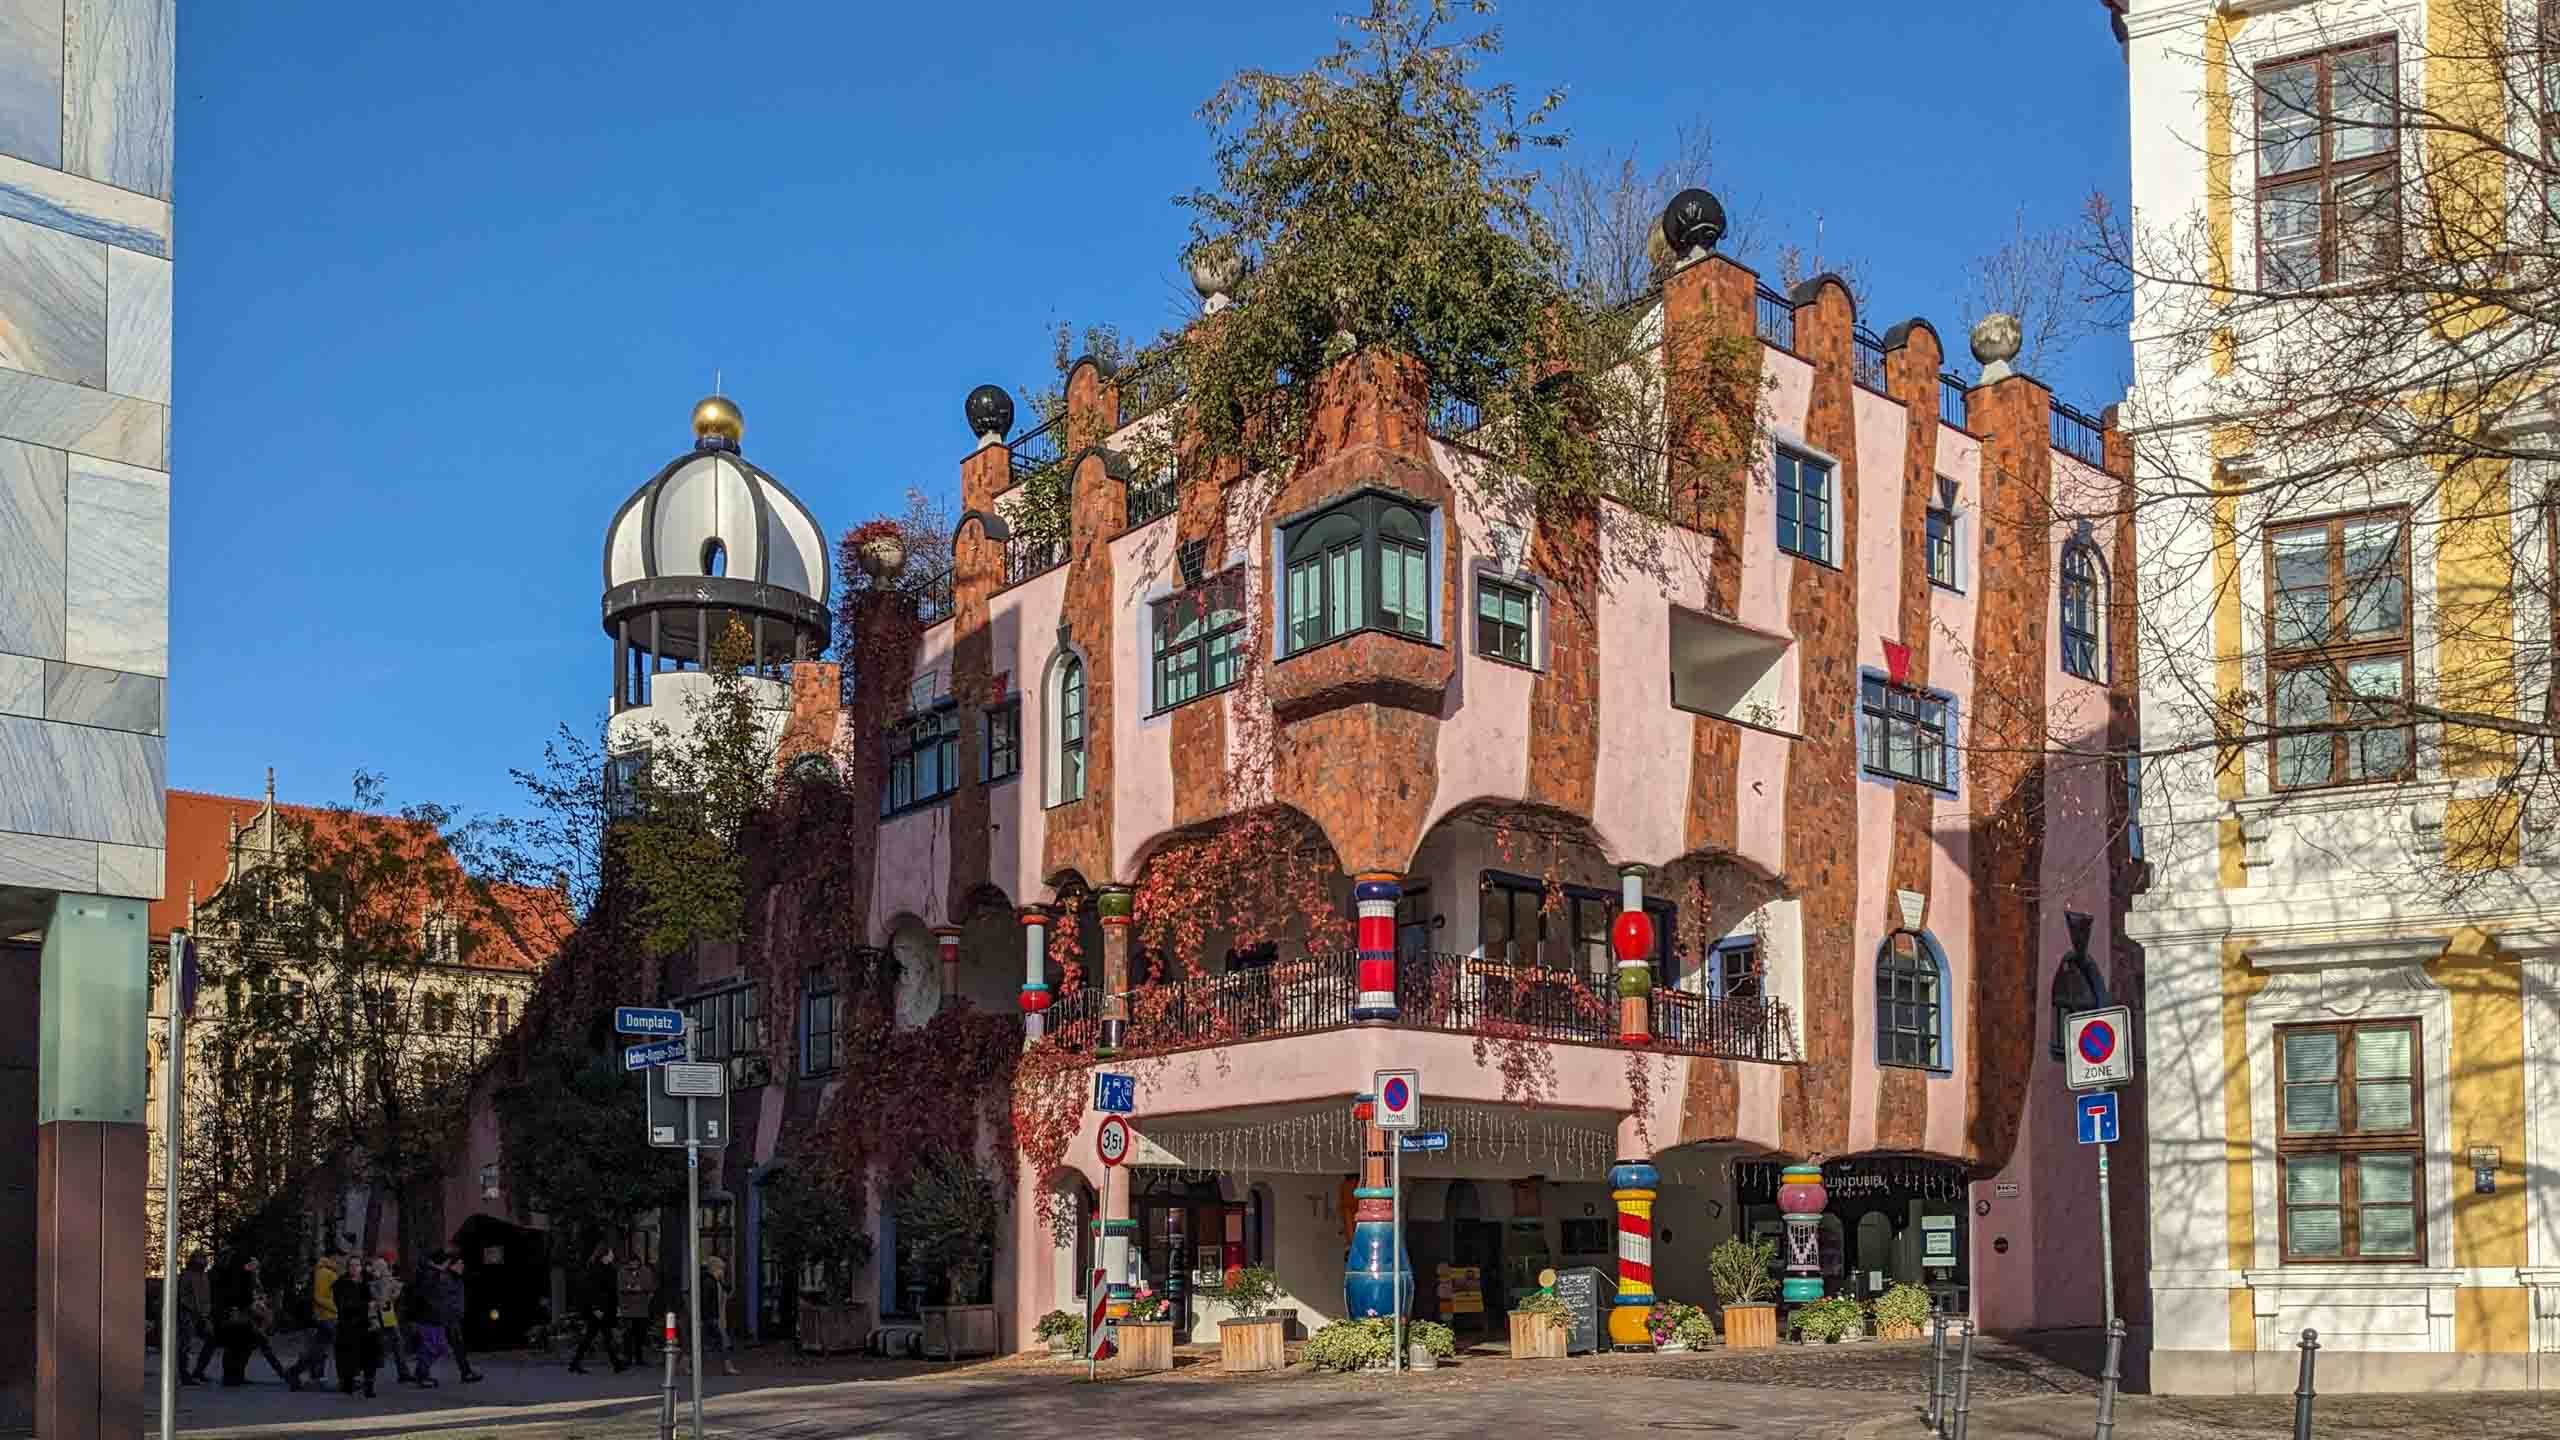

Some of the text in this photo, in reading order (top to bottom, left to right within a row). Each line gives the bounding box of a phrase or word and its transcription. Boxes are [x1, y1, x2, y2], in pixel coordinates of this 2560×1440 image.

[626, 1013, 673, 1030] Domplatz
[2084, 1065, 2113, 1079] ZONE
[1385, 1113, 1408, 1122] ZONE
[1102, 1128, 1123, 1152] 3,5t
